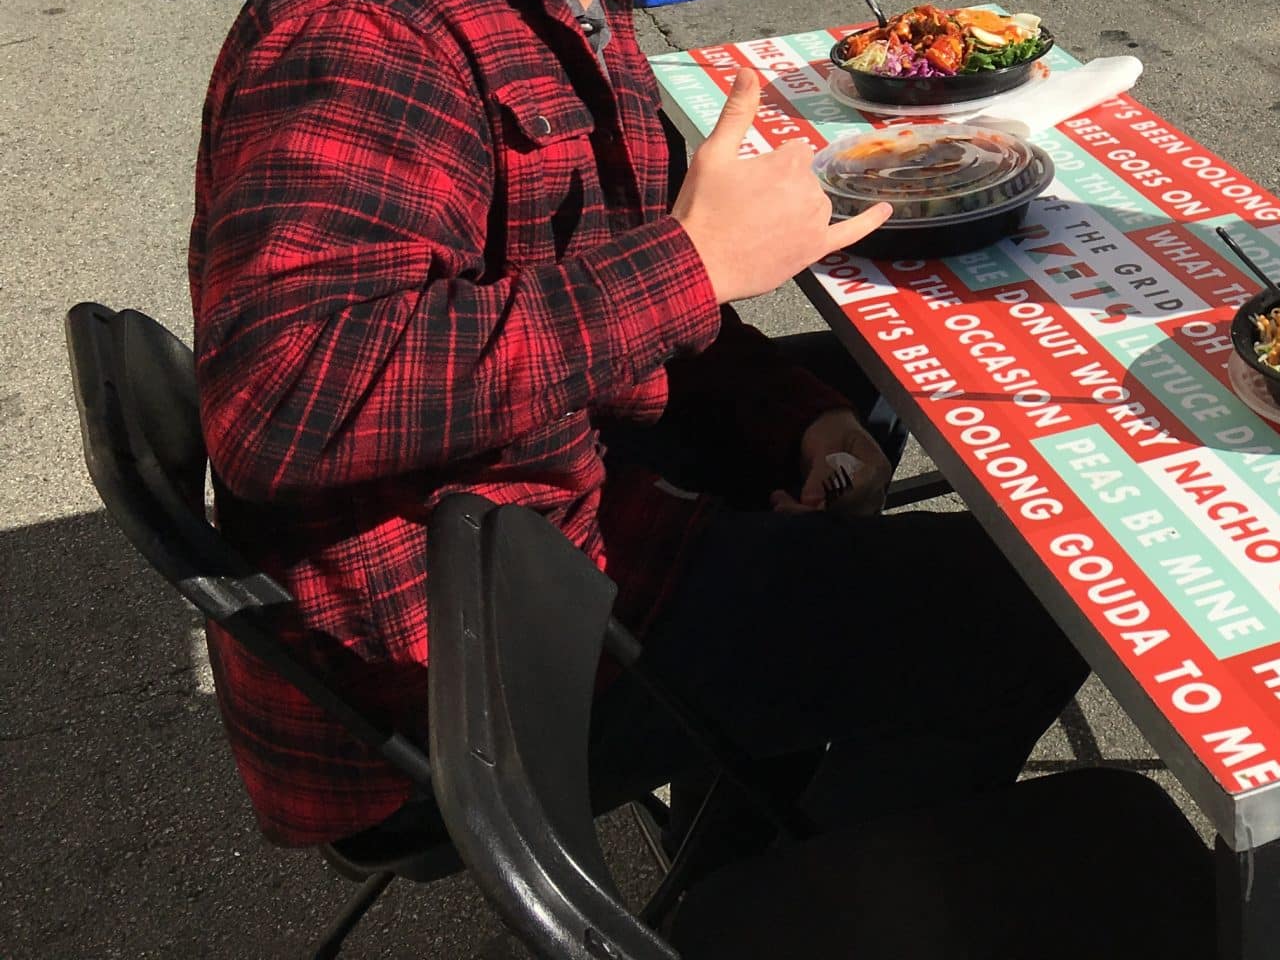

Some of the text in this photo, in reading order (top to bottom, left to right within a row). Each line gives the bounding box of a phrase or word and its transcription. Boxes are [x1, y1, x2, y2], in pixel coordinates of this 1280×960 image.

[750, 40, 785, 60] THE
[768, 60, 821, 96] CRUST
[1064, 117, 1212, 225] BEET GOES ON
[1129, 119, 1193, 155] BEEN
[1074, 172, 1148, 224] THYME
[1065, 220, 1119, 254] THE
[1113, 262, 1184, 312] GRID
[1145, 228, 1227, 281] WHAT
[909, 273, 964, 311] THE
[943, 314, 1071, 429] OCCASION
[993, 288, 1180, 450] DONUT WORRY
[1116, 332, 1231, 425] LETTUCE
[1181, 320, 1232, 355] OH
[857, 301, 915, 342] IT'S
[892, 343, 966, 402] BEEN
[944, 405, 1064, 523] OOLONG
[1050, 532, 1171, 656] GOUDA
[1154, 660, 1222, 714] TO
[1054, 436, 1266, 644] PEAS BE MINE
